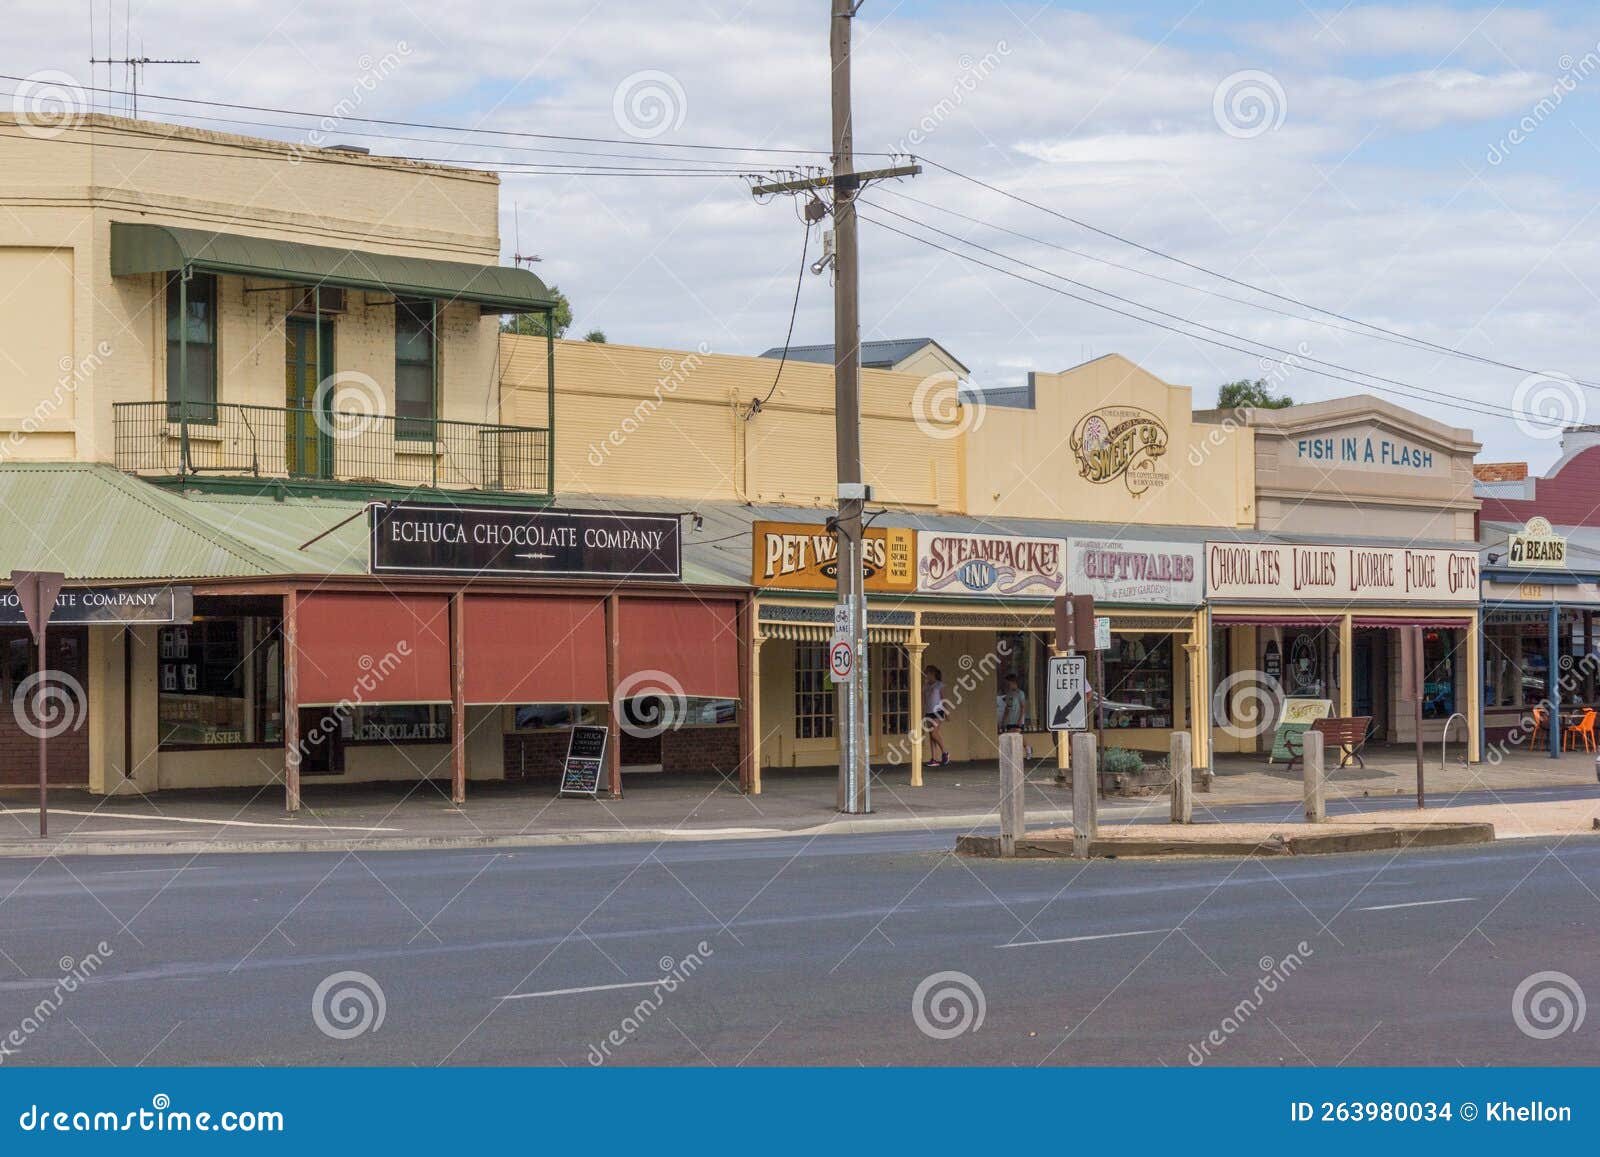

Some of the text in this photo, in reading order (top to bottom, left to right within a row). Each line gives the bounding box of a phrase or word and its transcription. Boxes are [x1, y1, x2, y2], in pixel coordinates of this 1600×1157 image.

[1090, 428, 1137, 481] SWEET
[1298, 437, 1433, 468] FISH IN A FLASH
[392, 521, 663, 550] ECHUCA CHOCOLATE COMPANY
[764, 533, 809, 578] PET
[929, 537, 1060, 579] STEAMPACKET
[1526, 541, 1563, 560] BEANS
[965, 563, 990, 588] INN
[1084, 550, 1194, 582] GIFTWARES
[1211, 546, 1477, 594] CHOCOLATES LOLLIES LICORICE FUDGE GIFTS
[82, 593, 157, 606] COMPANY
[836, 625, 849, 633] LANE
[834, 651, 850, 667] 50
[1056, 664, 1080, 675] KEEP
[1056, 679, 1080, 690] LEFT
[204, 731, 241, 744] EASTER
[358, 723, 446, 740] CHOCOLATES
